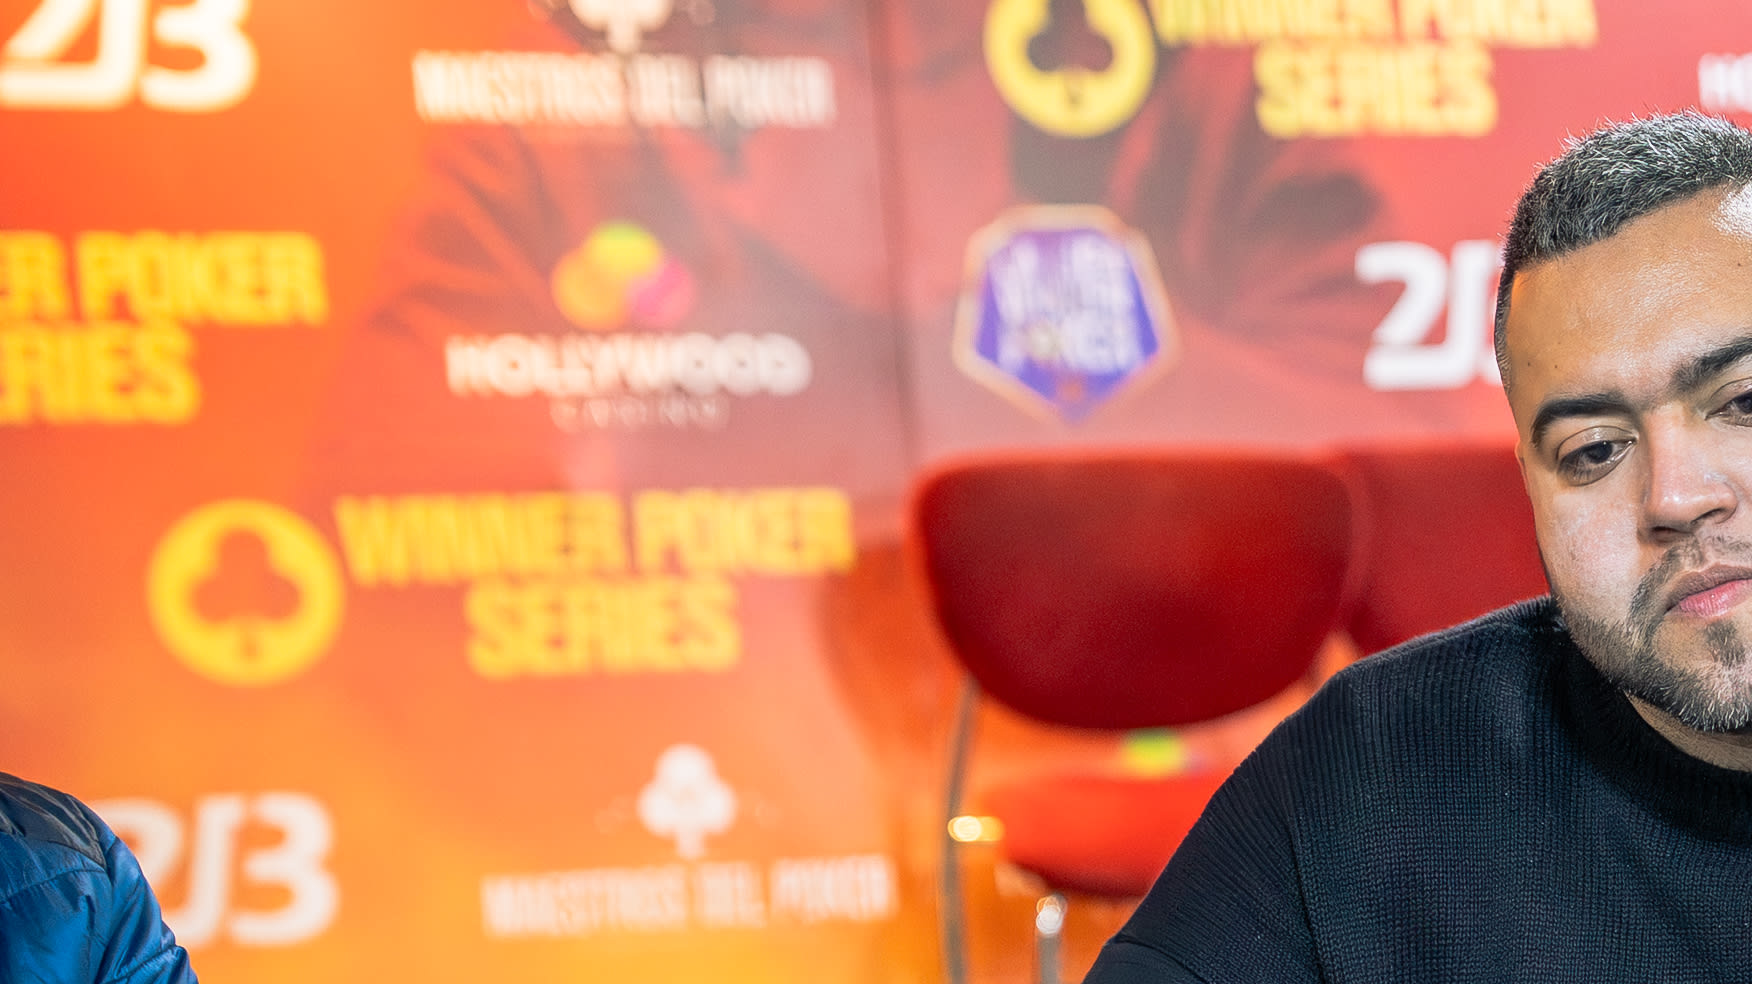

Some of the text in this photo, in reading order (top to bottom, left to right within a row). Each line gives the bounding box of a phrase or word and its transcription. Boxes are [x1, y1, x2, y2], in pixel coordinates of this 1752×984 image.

[1253, 42, 1497, 138] SERIES
[77, 230, 329, 326] POKER
[0, 320, 204, 424] RIES
[445, 332, 812, 397] HOLLYWOOD
[333, 488, 857, 586] WINNER POKER
[464, 574, 743, 680] SERIES
